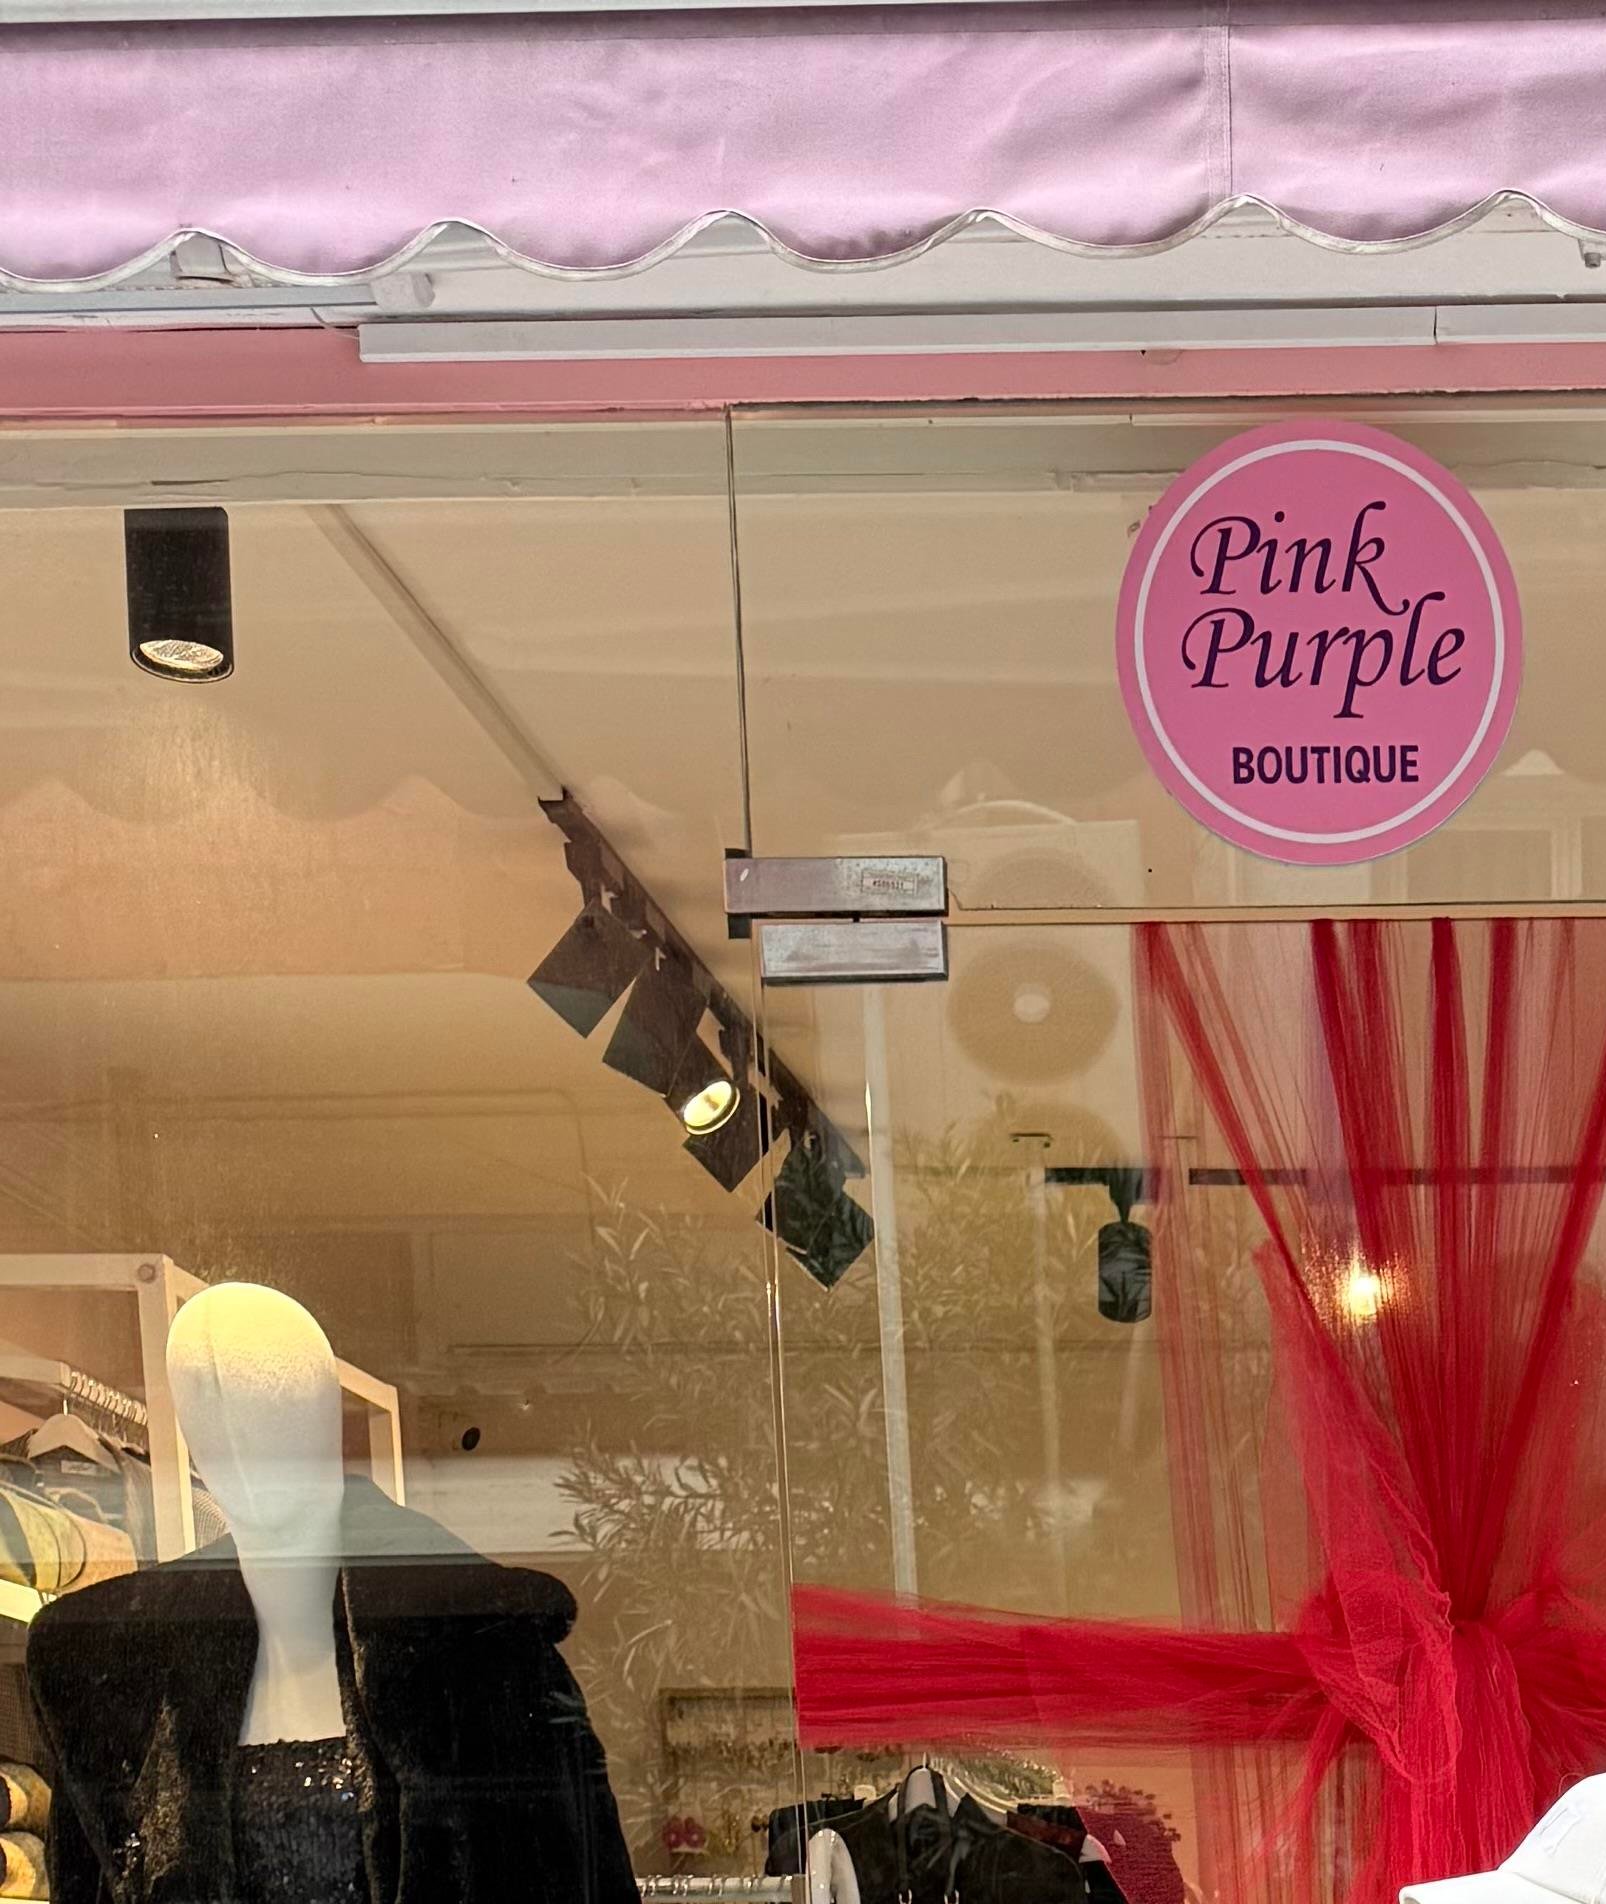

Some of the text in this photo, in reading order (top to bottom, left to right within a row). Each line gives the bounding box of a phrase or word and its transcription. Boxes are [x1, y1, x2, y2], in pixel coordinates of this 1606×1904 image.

[1190, 500, 1410, 616] Pink
[1181, 591, 1466, 719] Purple
[1232, 745, 1419, 784] BOUTIQUE
